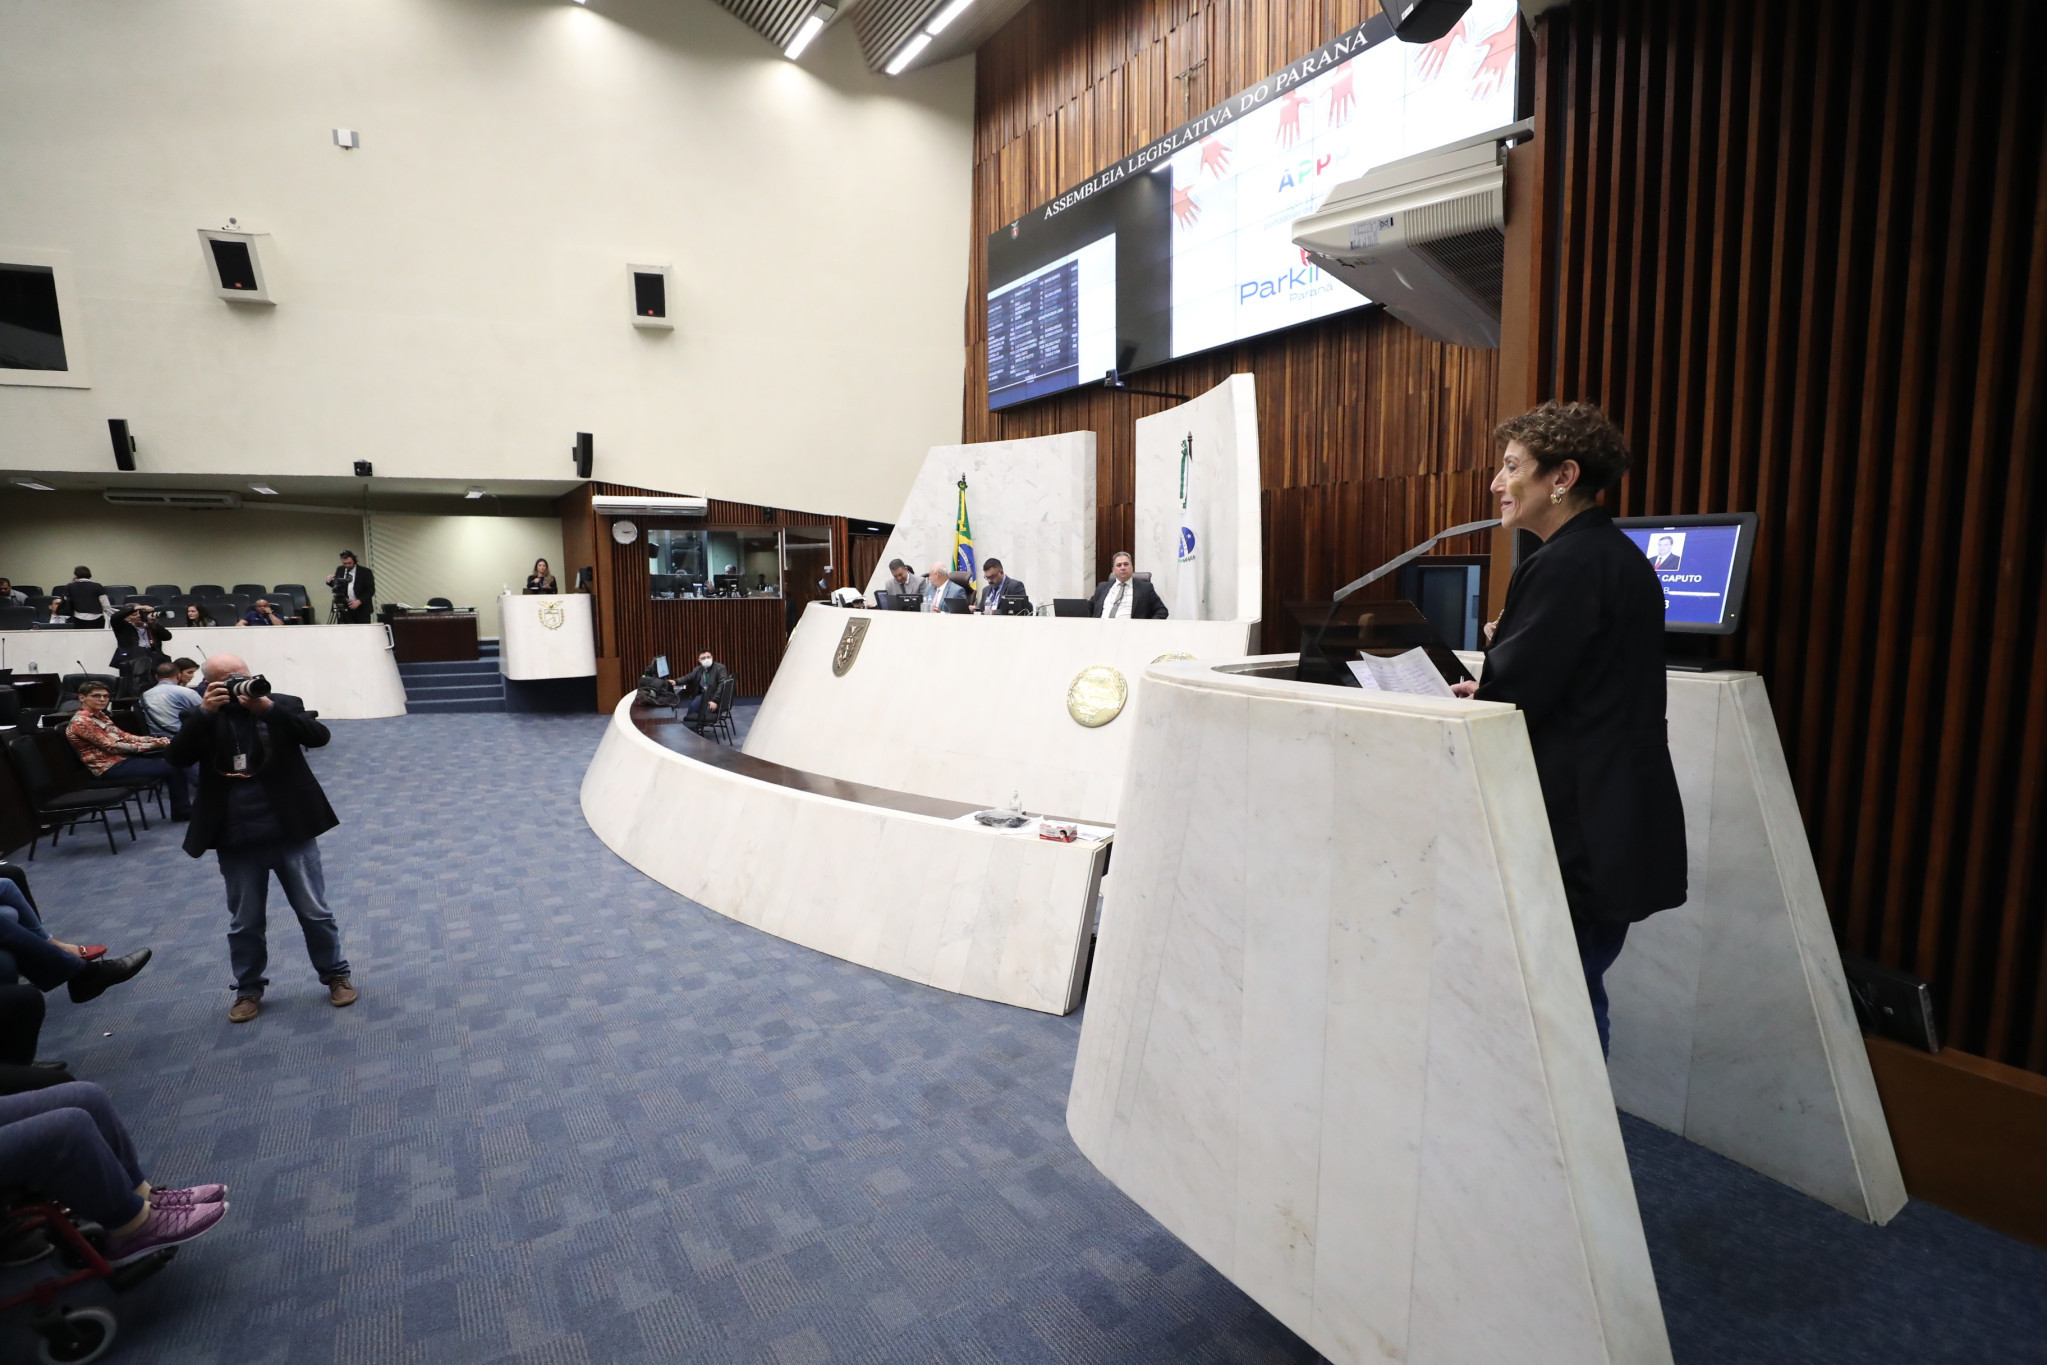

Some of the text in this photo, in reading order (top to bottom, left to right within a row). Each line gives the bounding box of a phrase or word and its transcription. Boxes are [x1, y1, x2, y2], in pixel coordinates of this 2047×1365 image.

[1044, 22, 1369, 220] ASSEMBLEIA LEGISLATIVA DO PARANÁ
[1289, 282, 1334, 302] Paraná
[1661, 574, 1703, 583] CAPUTO
